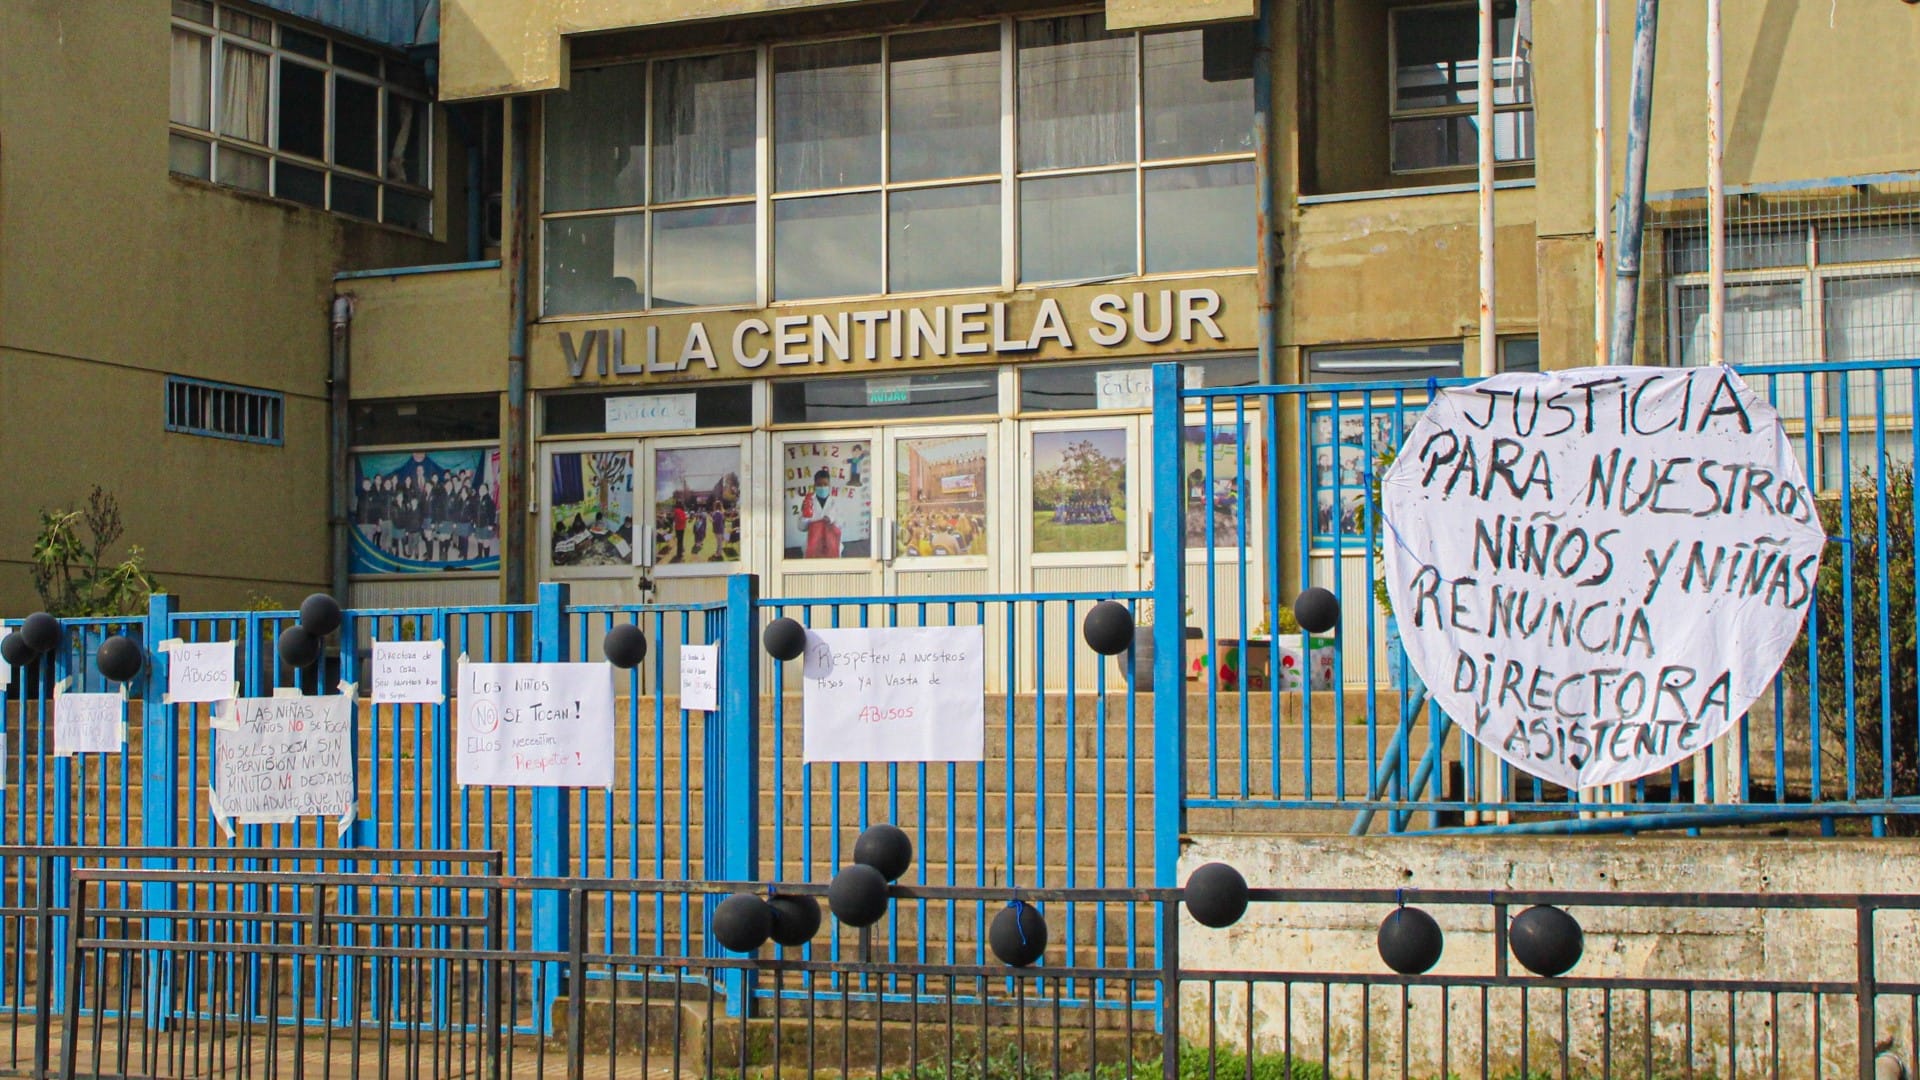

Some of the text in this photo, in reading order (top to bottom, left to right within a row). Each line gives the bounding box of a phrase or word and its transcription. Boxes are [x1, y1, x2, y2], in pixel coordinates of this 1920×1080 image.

[559, 288, 1226, 378] VILLA CENTINELA SUR
[1464, 372, 1753, 438] JUSTICIA
[1418, 429, 1812, 525] PARA NUESTROS
[1473, 511, 1622, 587] NIÑOS
[1681, 536, 1817, 610] NIÑAS
[1409, 565, 1656, 658] RENUNCIA
[174, 650, 191, 664] NO
[1453, 649, 1731, 723] DIRECTORA
[245, 699, 273, 724] LAS
[275, 702, 314, 719] NIÑAS
[288, 720, 304, 732] NO
[476, 705, 496, 727] NO
[503, 707, 522, 723] SE
[318, 737, 342, 753] SIN
[321, 752, 342, 768] UN
[1503, 718, 1702, 770] ASISTENTE
[228, 772, 273, 793] MINUTO
